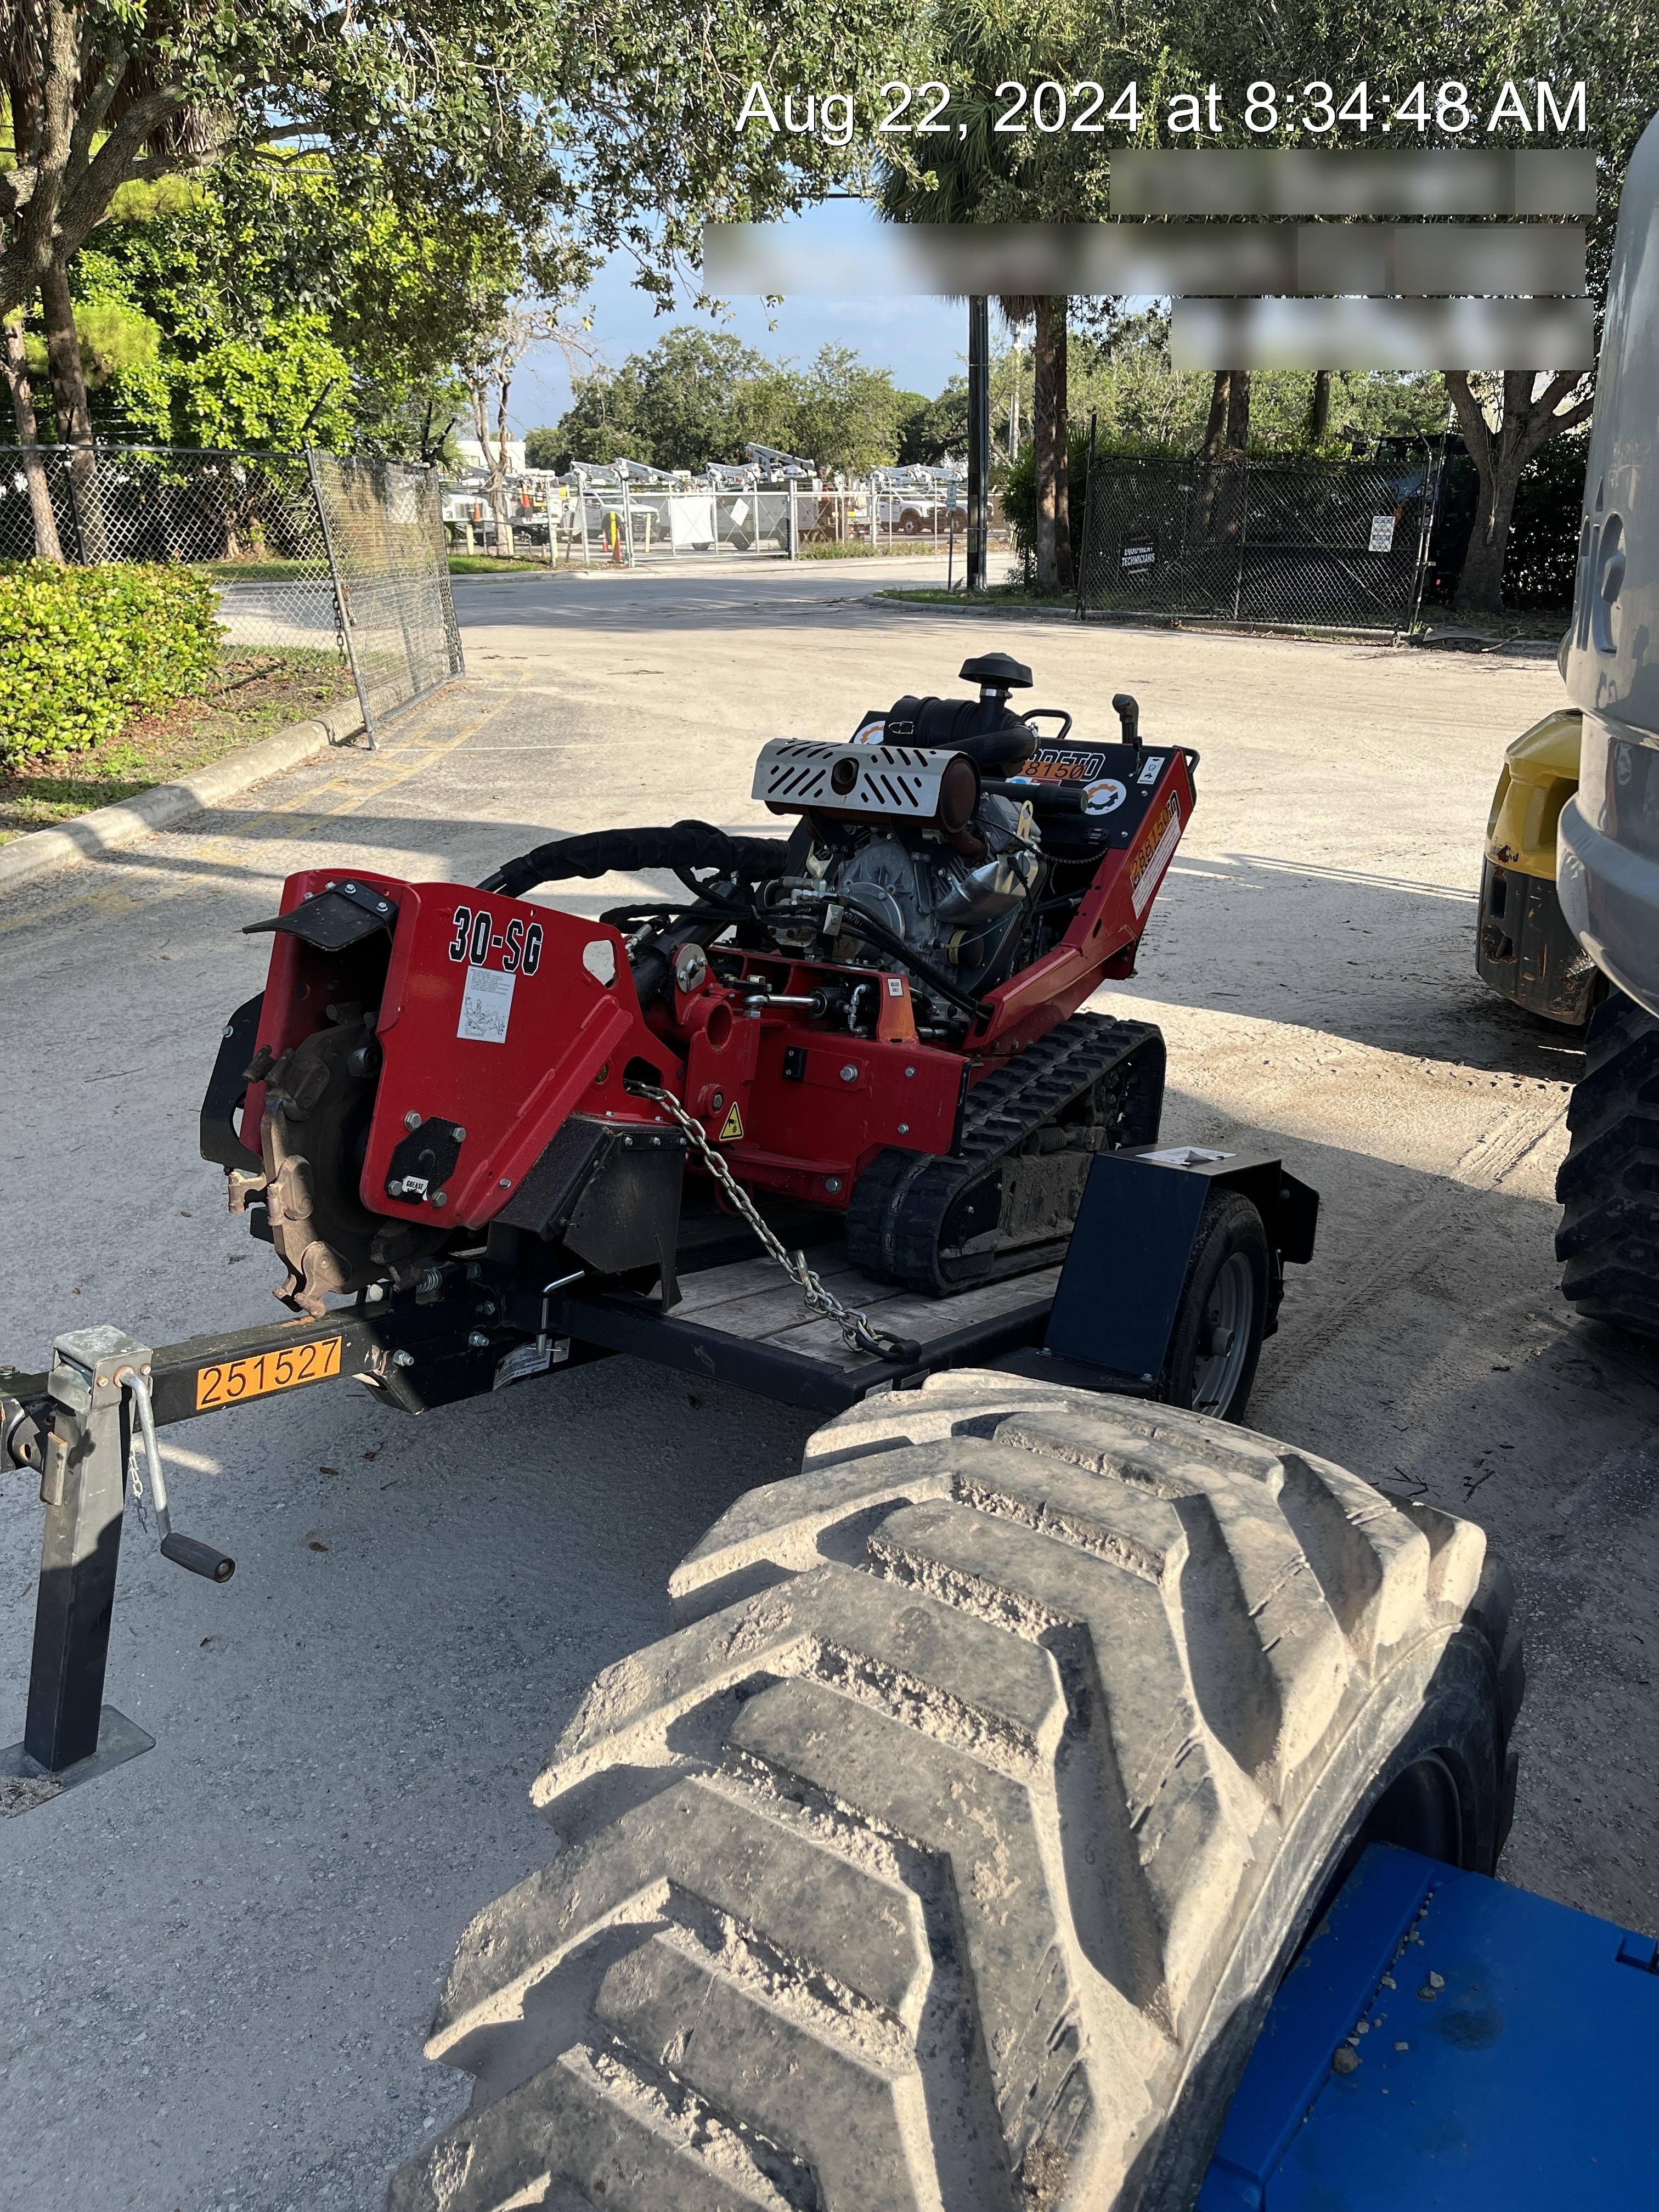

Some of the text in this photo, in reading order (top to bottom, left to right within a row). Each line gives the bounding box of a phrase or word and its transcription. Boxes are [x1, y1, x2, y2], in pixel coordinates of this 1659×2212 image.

[1121, 553, 1155, 566] TECHNICIANS
[1131, 806, 1170, 881] 288150
[448, 905, 544, 976] 30-SG
[406, 1180, 424, 1190] GREASE
[201, 1339, 339, 1405] 251527
